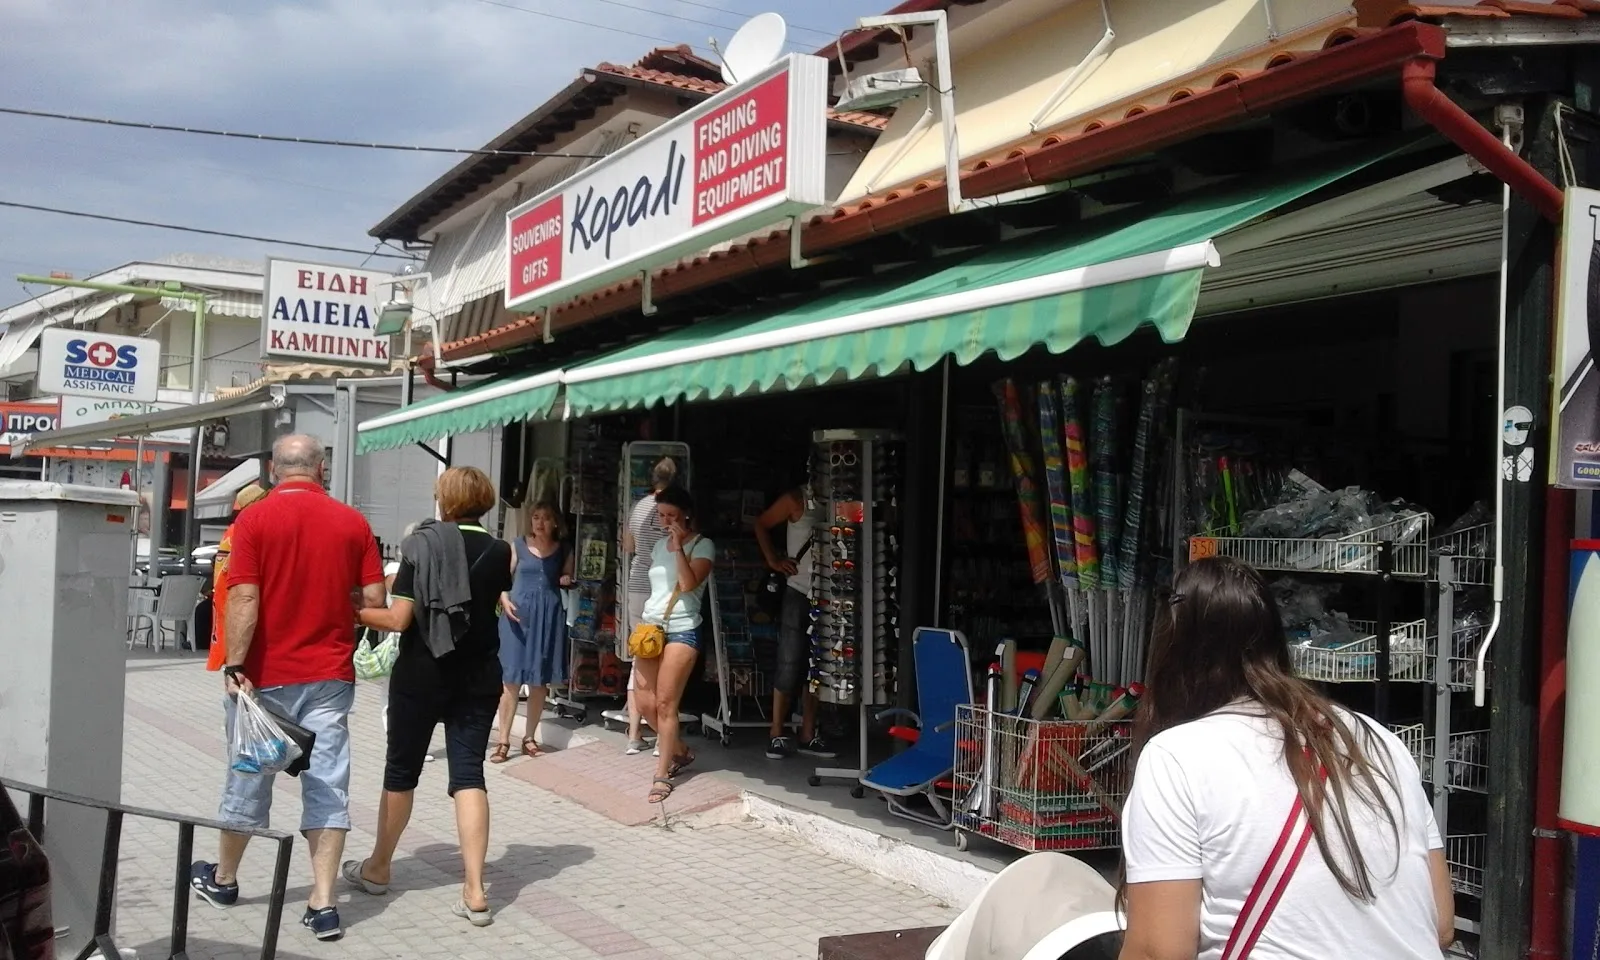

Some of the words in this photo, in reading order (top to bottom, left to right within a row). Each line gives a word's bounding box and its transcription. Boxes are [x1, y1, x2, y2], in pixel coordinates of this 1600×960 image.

[699, 98, 757, 150] FISHING
[698, 149, 728, 183] AND
[731, 121, 782, 169] DIVING
[698, 156, 783, 216] EQUIPMENT
[512, 215, 562, 255] SOUVENIRS
[297, 269, 368, 295] ΕΙΔΗ
[522, 257, 549, 285] GIFTS
[272, 296, 378, 330] ΑΛΙΕΙΑ
[65, 339, 138, 369] SOS
[270, 329, 388, 360] ΚΑΜΠΙΝΓΚ
[63, 379, 134, 394] ASSISTANCE
[66, 366, 133, 383] MEDICAL
